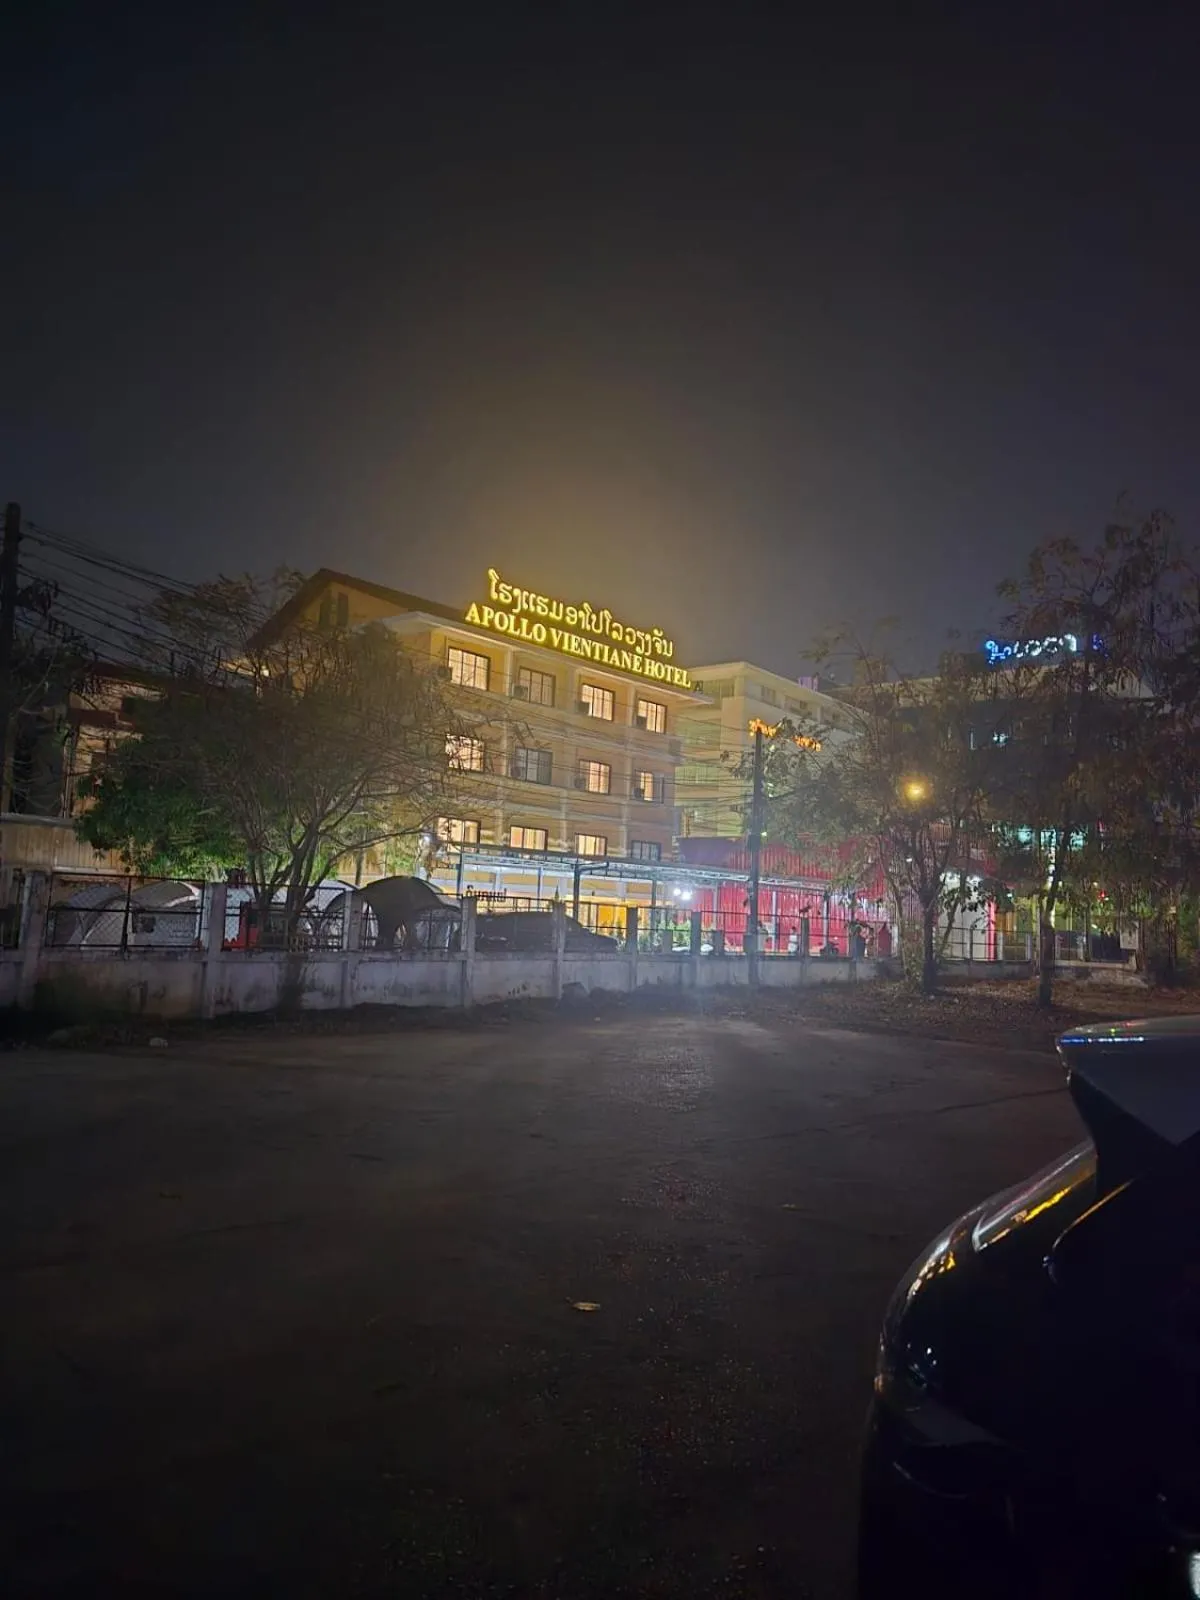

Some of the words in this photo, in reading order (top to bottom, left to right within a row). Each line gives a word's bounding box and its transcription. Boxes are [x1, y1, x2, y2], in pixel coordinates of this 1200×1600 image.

[465, 602, 547, 642] APOLLO
[549, 628, 643, 673] VIENTIANE
[643, 657, 691, 688] HOTEL
